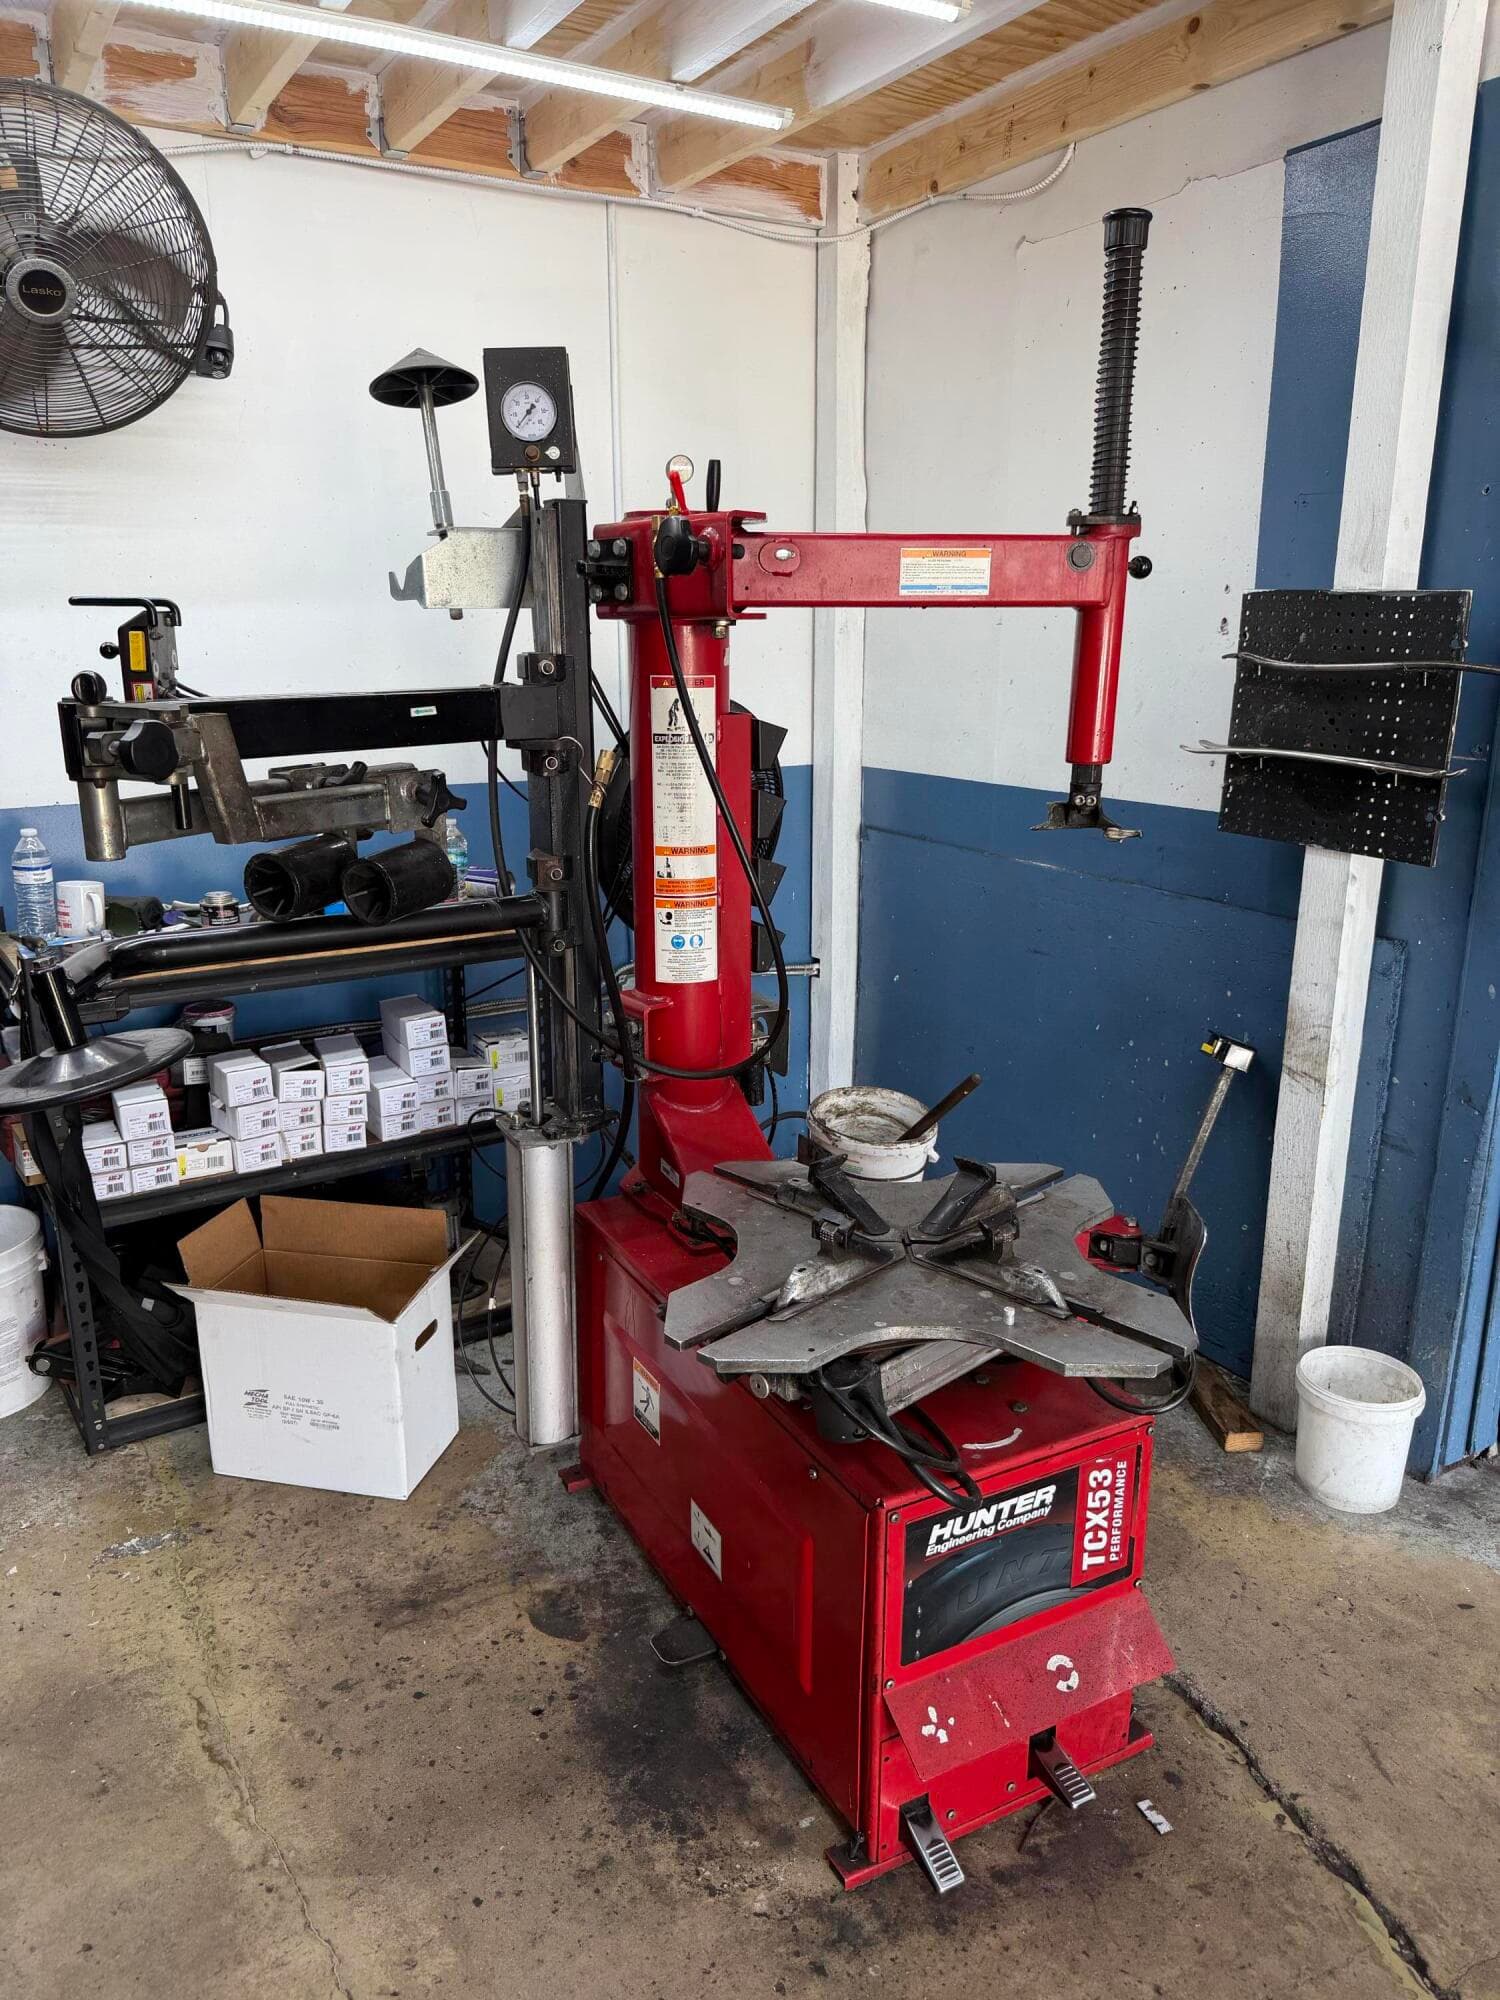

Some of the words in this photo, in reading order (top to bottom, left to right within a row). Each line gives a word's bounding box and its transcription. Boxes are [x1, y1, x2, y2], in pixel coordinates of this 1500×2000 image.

[22, 284, 62, 297] Lasko
[932, 550, 967, 558] WARNING
[671, 846, 708, 855] WARNING
[674, 900, 708, 909] WARNING
[284, 1393, 296, 1401] SAE
[928, 1484, 1057, 1545] HUNTER
[1109, 1461, 1127, 1562] PERFORMANCE
[1081, 1468, 1113, 1571] TCX53
[925, 1524, 996, 1557] Engineering
[997, 1505, 1052, 1531] Company
